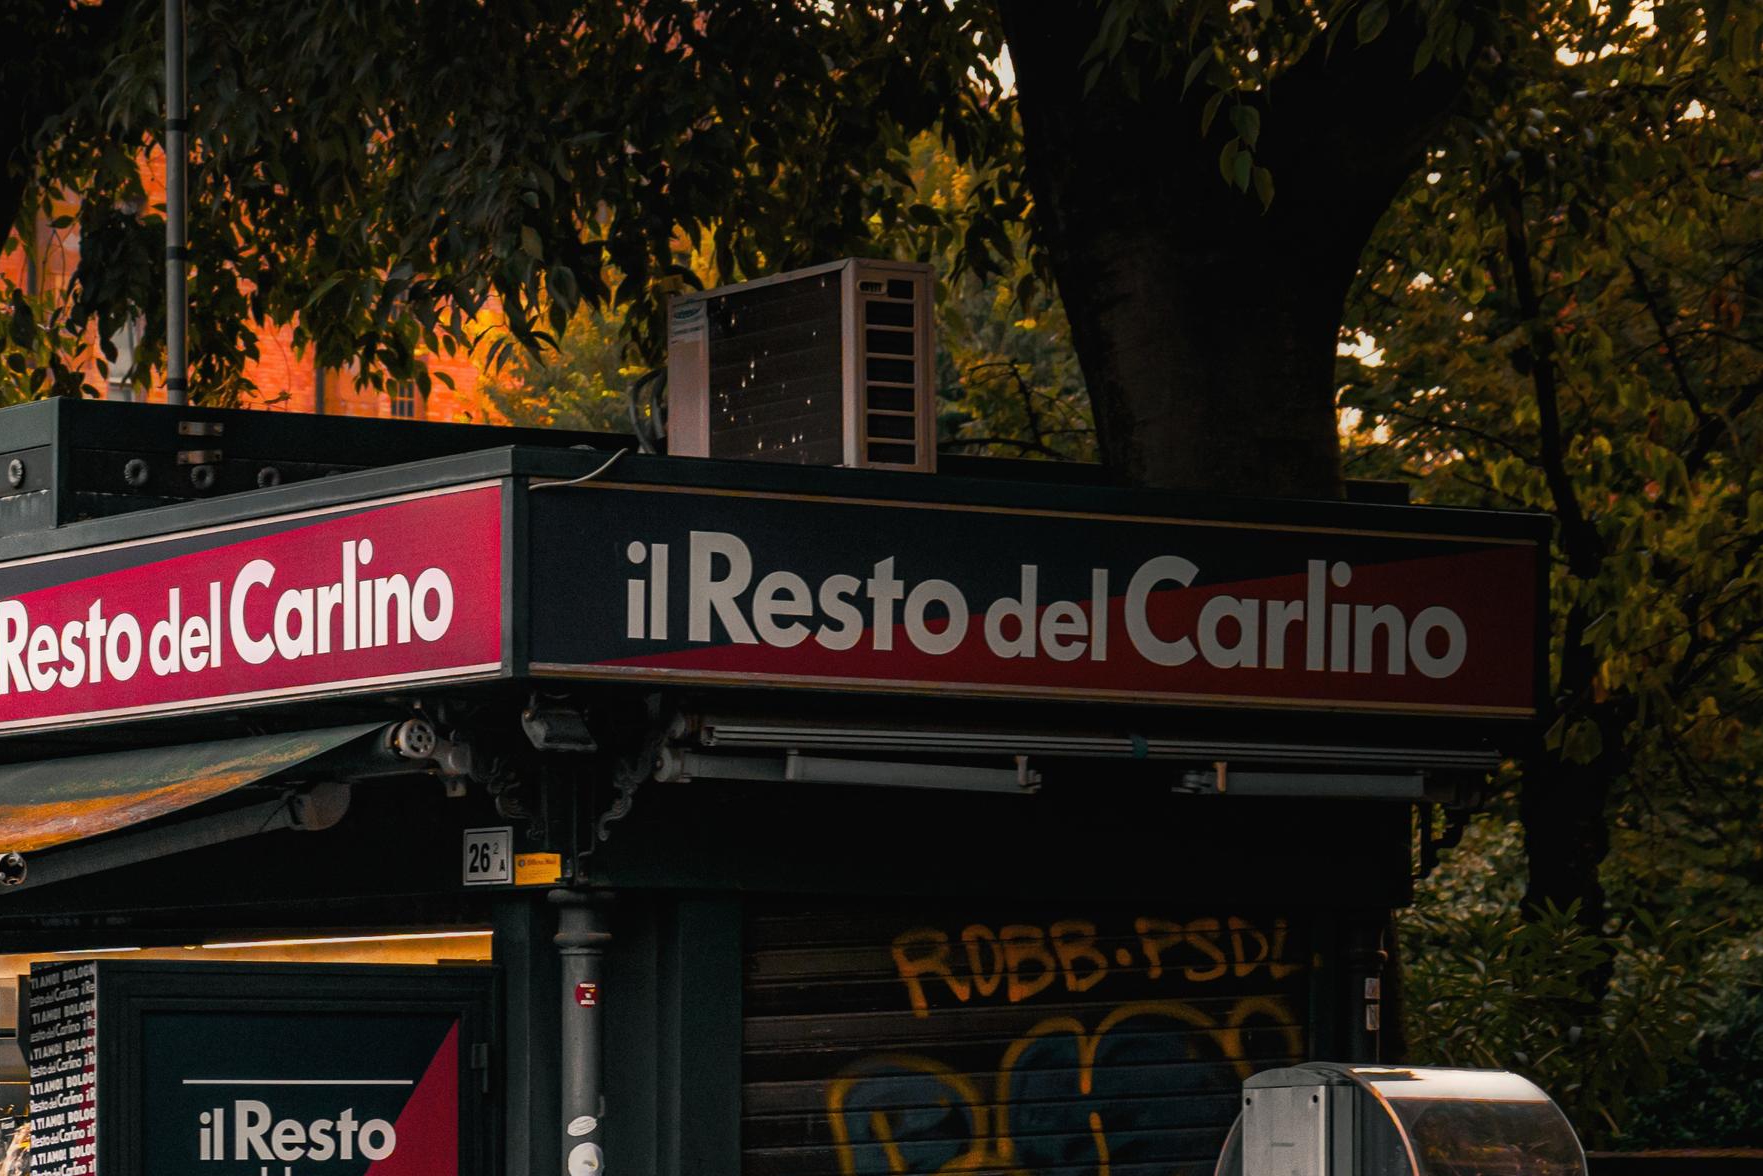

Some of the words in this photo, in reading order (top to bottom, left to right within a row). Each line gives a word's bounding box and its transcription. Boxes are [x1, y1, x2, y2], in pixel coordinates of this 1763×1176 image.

[148, 581, 222, 677] del
[229, 538, 454, 665] Carlino
[627, 540, 669, 641] il
[688, 530, 969, 655] Resto
[984, 564, 1108, 662] del
[1125, 555, 1467, 679] Carlino
[469, 843, 490, 873] 26
[199, 1107, 224, 1161] il
[235, 1099, 397, 1161] Resto
